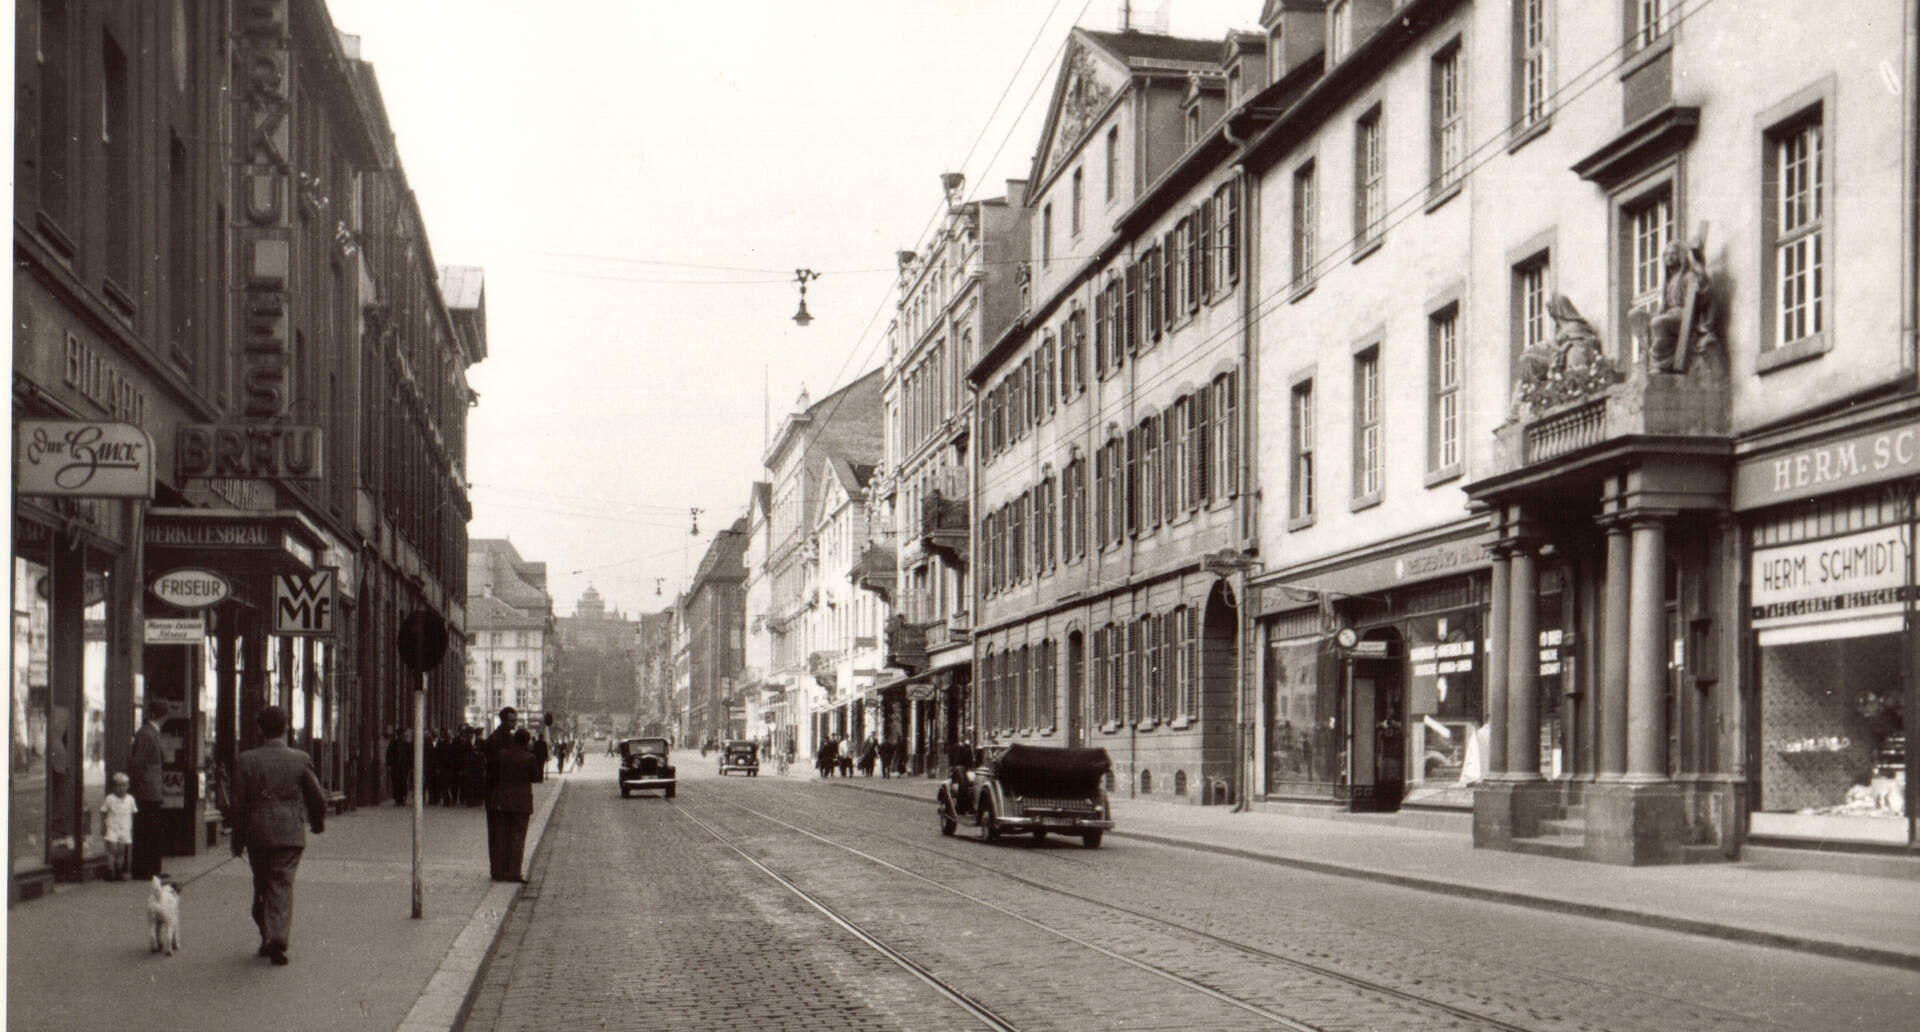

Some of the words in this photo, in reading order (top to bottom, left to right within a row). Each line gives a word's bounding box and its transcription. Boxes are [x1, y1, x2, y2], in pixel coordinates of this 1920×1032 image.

[1773, 443, 1867, 492] HERM.
[160, 579, 222, 597] FRISEUR
[1763, 555, 1812, 592] HERM.
[1820, 540, 1896, 582] SCHMIDT
[279, 573, 330, 629] WMF
